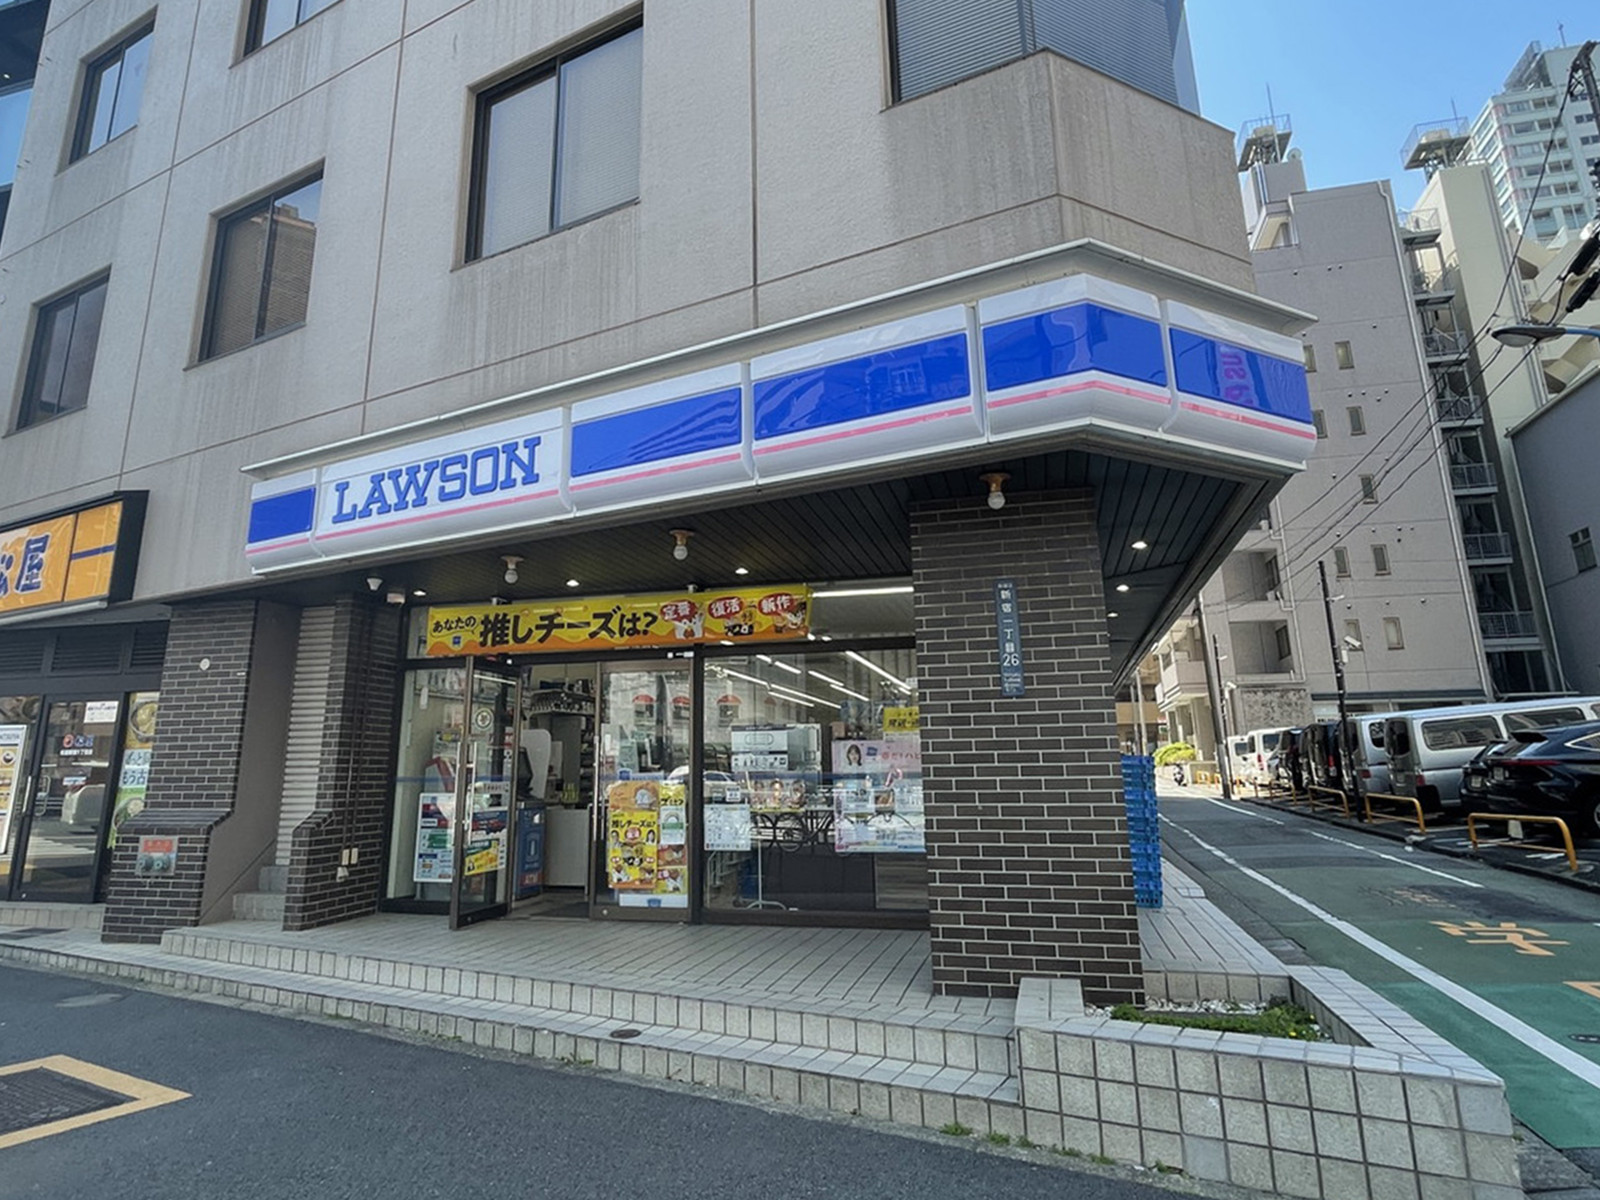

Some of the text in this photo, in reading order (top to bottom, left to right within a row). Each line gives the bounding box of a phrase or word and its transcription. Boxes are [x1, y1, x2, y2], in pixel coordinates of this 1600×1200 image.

[332, 436, 541, 524] LAWSON
[662, 601, 692, 620] 定番
[711, 598, 741, 617] 復活
[761, 595, 792, 613] 新作
[432, 605, 658, 648] あなたの 推しチーズは?
[1003, 653, 1020, 667] 26
[1429, 921, 1571, 956] 学
